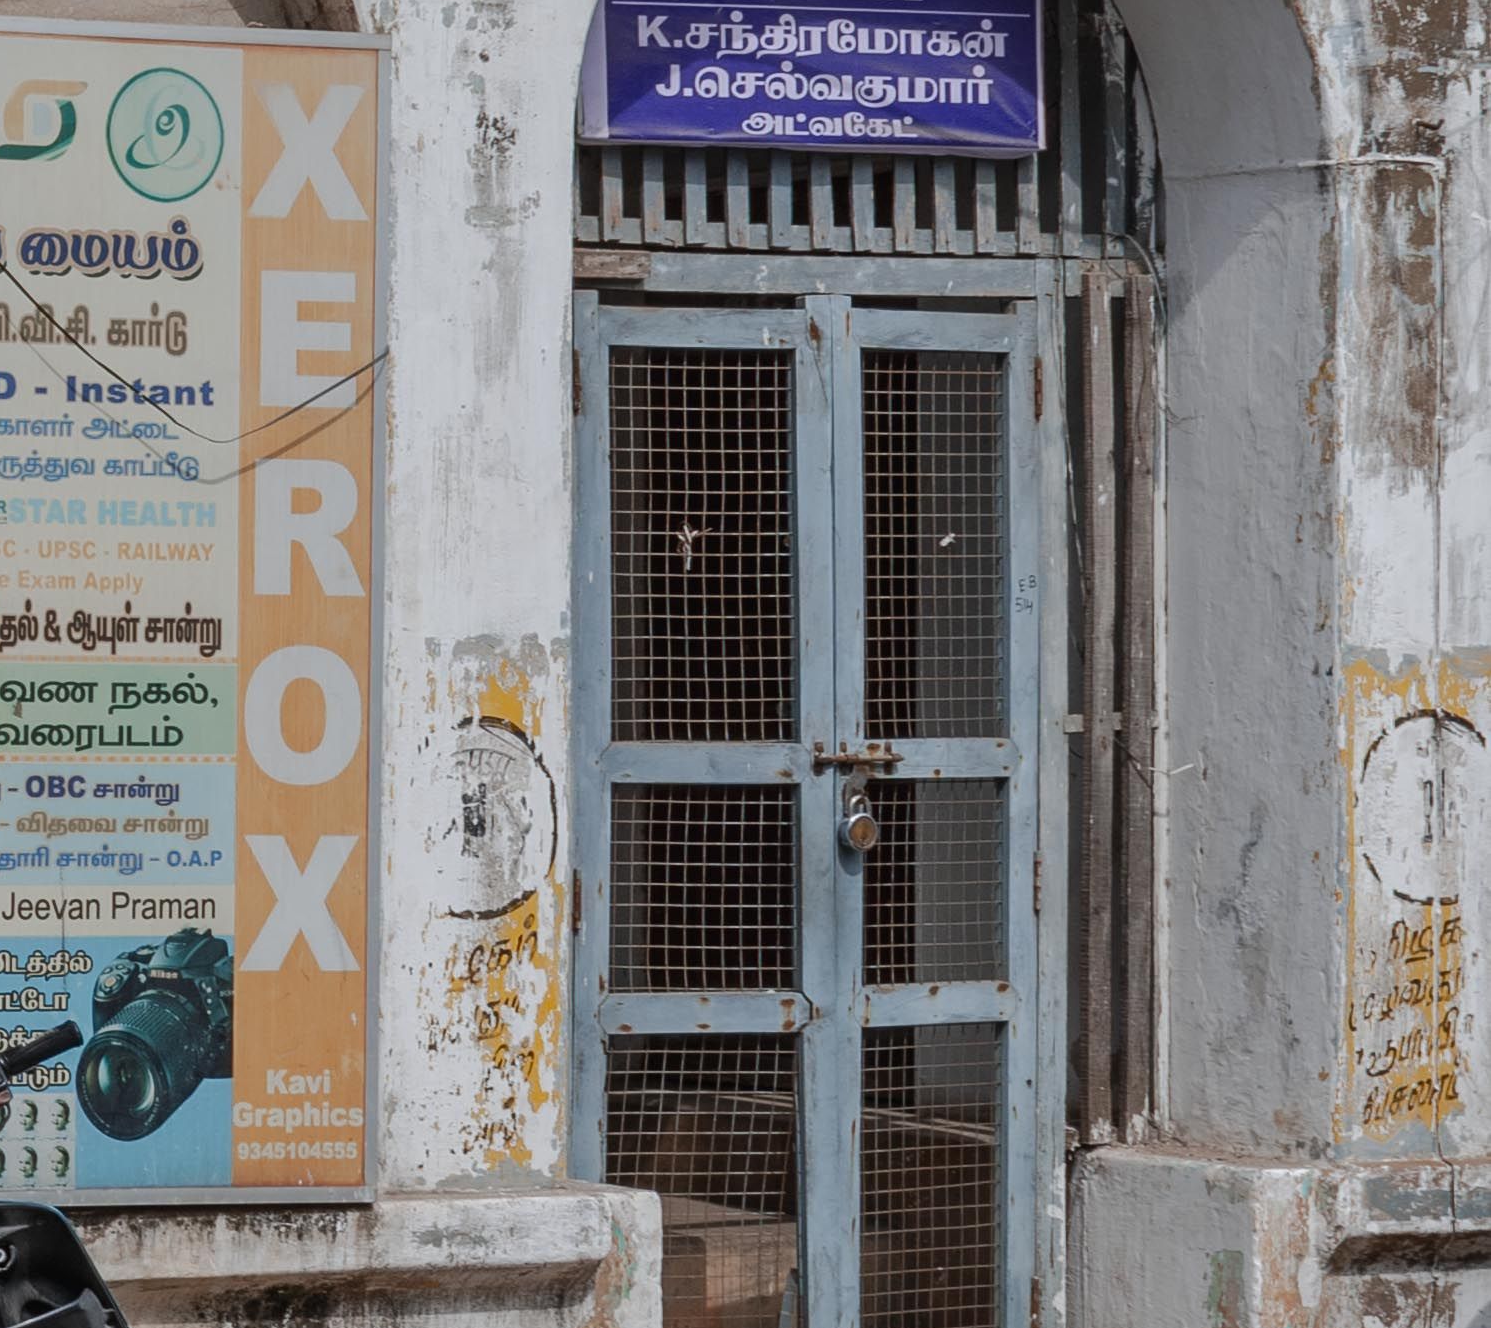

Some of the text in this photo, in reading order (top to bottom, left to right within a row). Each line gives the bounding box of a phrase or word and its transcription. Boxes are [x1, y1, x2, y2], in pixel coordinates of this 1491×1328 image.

[741, 111, 919, 139] அட்வகேட்
[19, 217, 203, 279] மையம்
[106, 302, 189, 357] கார்டு
[65, 375, 216, 408] Instant
[9, 499, 88, 526] STAR
[97, 500, 217, 528] HEALTH
[238, 82, 370, 974] XEROX
[38, 539, 97, 560] UPSC
[116, 541, 215, 562] RAILWAY
[17, 571, 77, 590] Exam
[83, 572, 144, 595] Apply
[43, 609, 62, 642] &
[144, 601, 222, 658] சான்று
[25, 775, 87, 799] OBC
[92, 775, 180, 806] சான்று
[55, 844, 143, 876] சான்று
[166, 850, 223, 868] O.A.P
[1, 891, 101, 922] Jeevan
[110, 891, 217, 921] Praman
[265, 1068, 332, 1096] Kavi
[232, 1101, 364, 1134] Graphics
[237, 1141, 358, 1161] 9345104555
